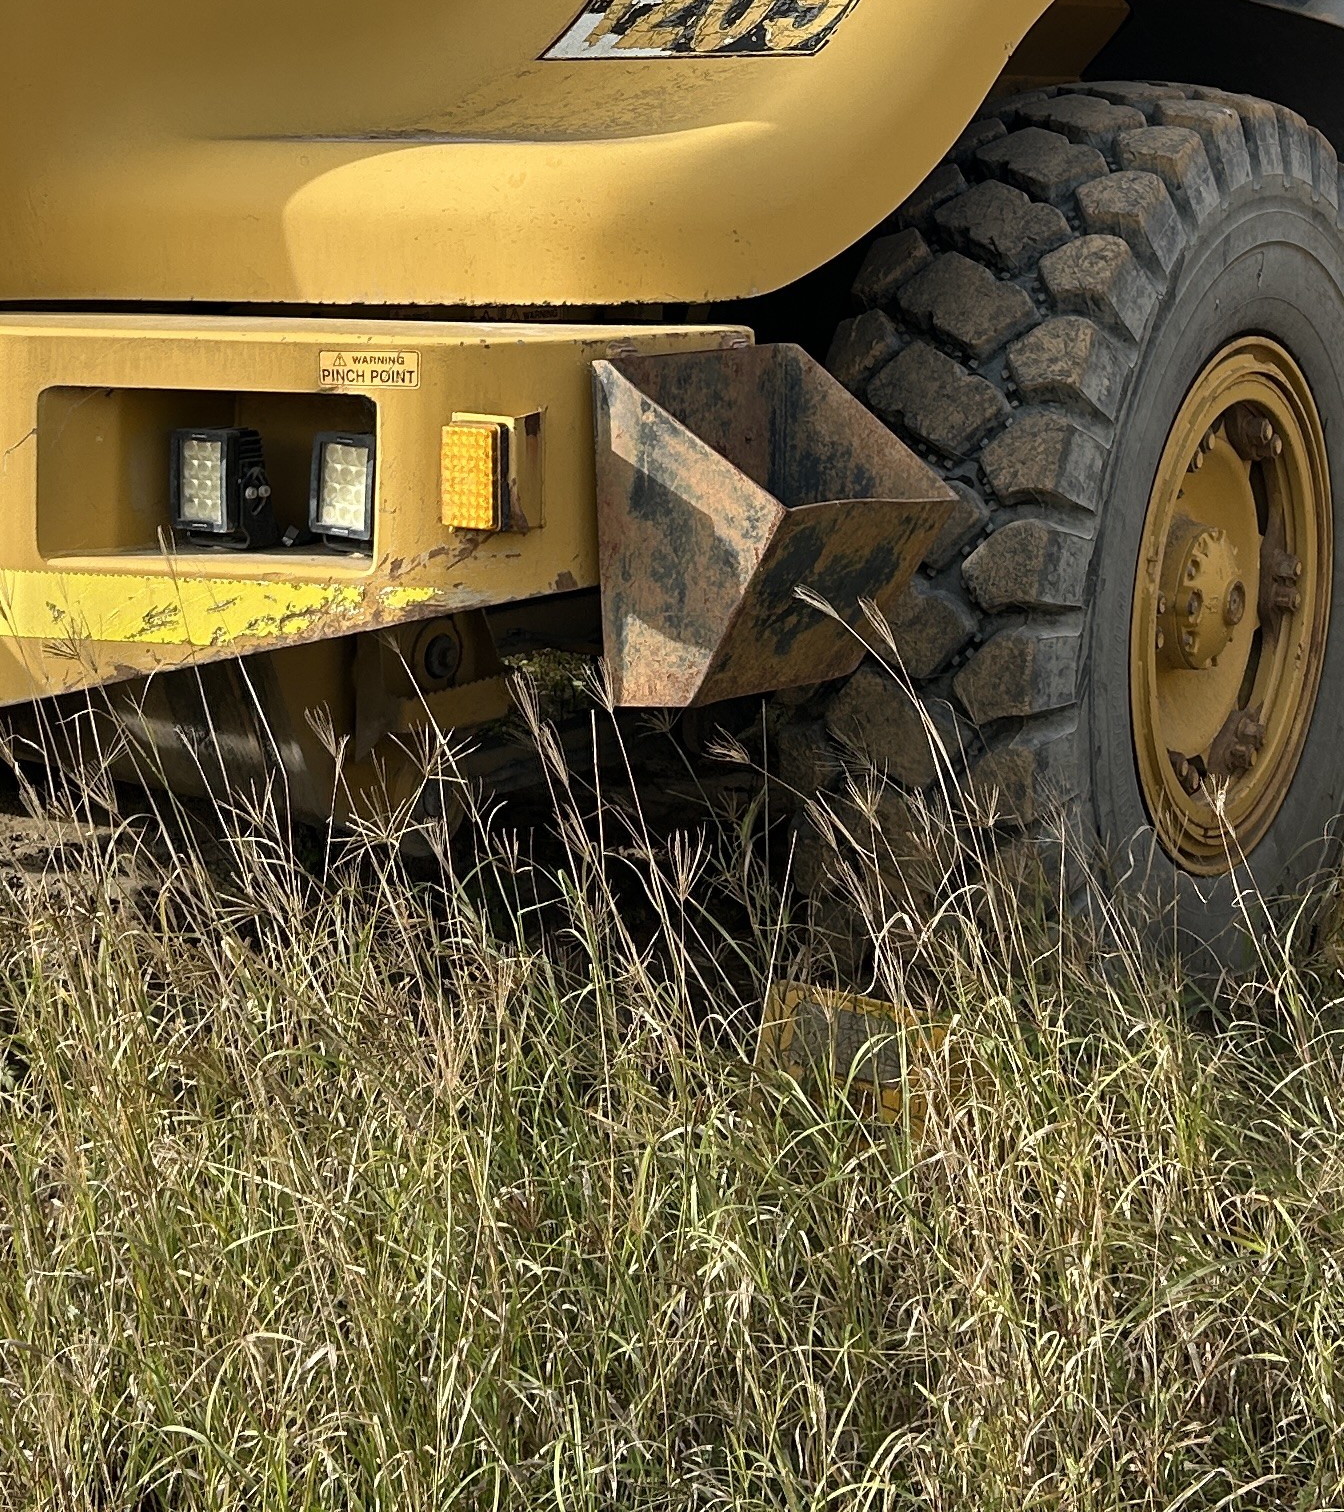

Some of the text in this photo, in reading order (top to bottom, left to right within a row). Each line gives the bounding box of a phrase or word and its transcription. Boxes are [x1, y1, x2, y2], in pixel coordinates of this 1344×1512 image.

[352, 355, 406, 366] WARNING
[321, 368, 416, 384] PINCH POINT
